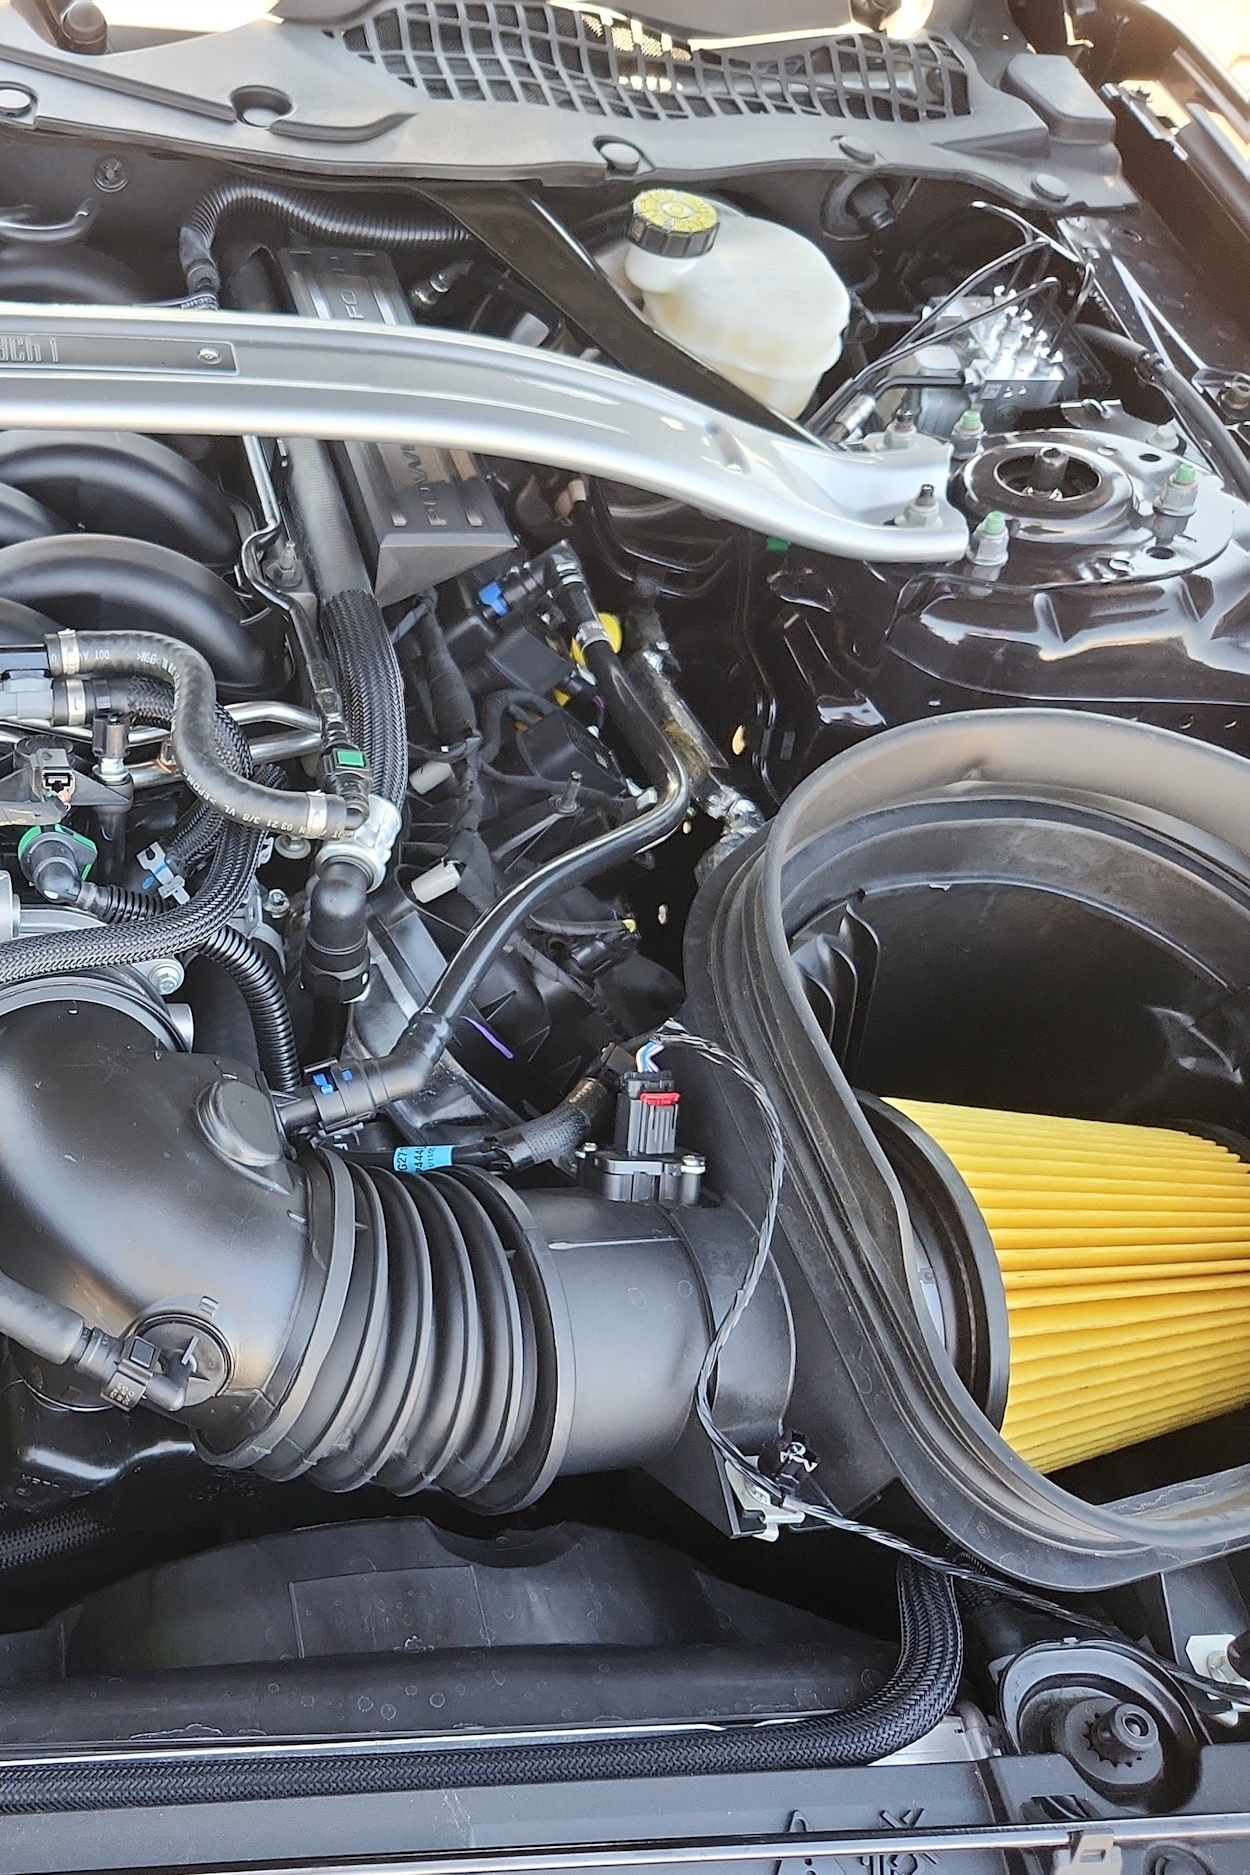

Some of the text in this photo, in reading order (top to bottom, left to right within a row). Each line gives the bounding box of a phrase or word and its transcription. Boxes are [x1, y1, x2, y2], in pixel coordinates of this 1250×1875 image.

[49, 337, 60, 363] 1
[95, 650, 110, 660] DOT
[182, 768, 217, 805] >EPDM<
[223, 804, 236, 817] VL
[242, 813, 261, 825] 3/8
